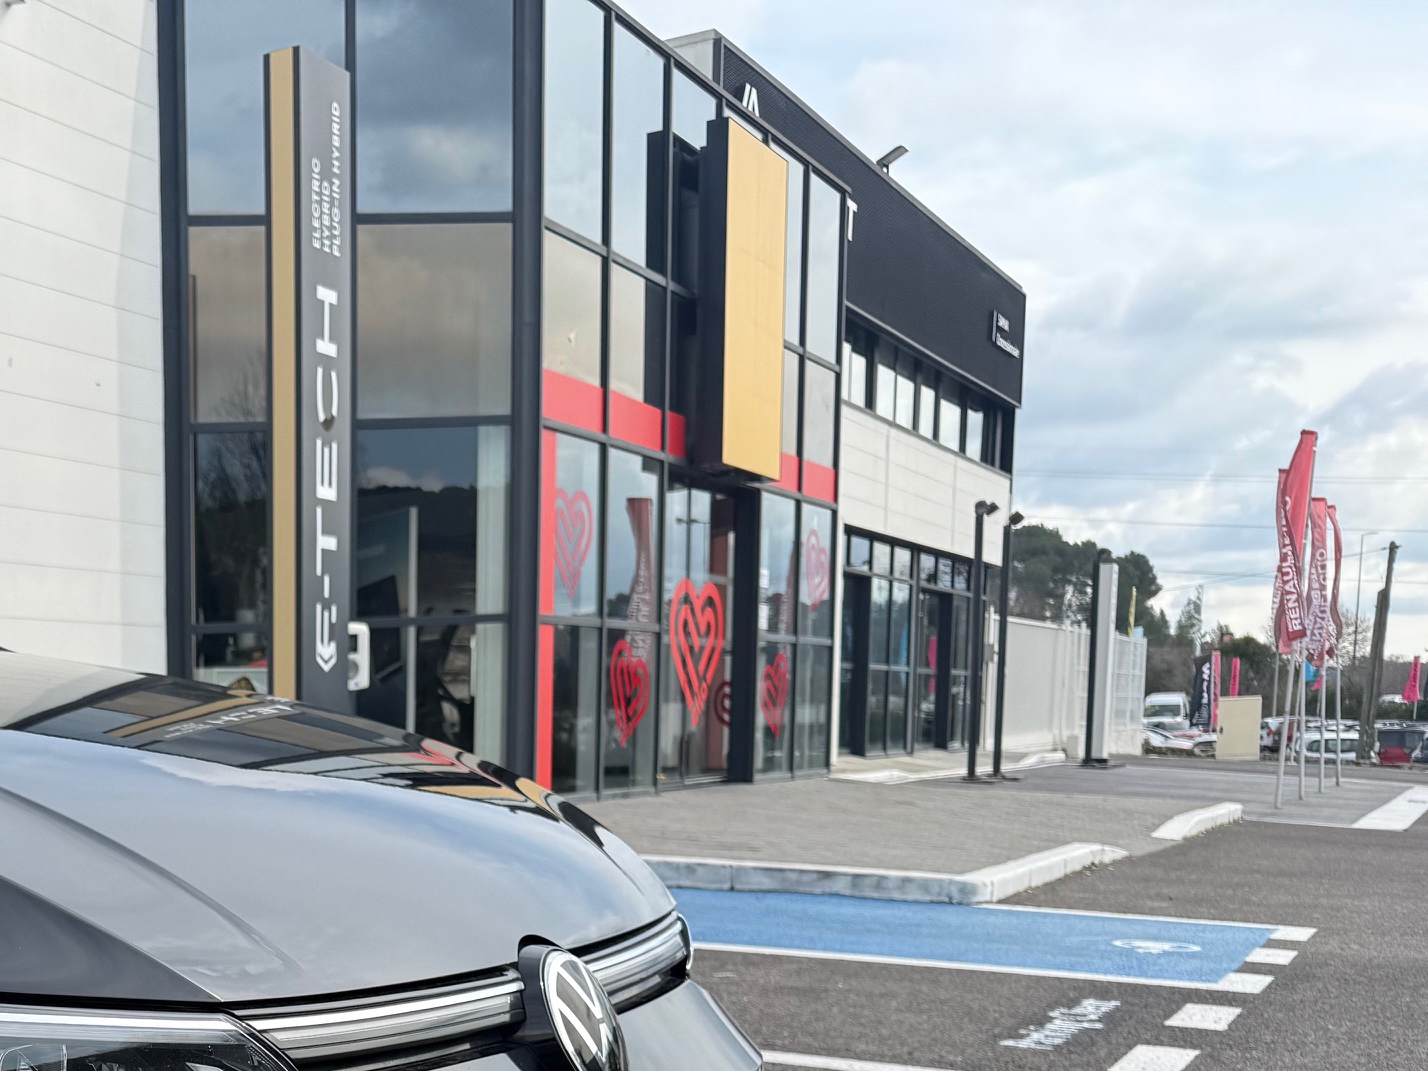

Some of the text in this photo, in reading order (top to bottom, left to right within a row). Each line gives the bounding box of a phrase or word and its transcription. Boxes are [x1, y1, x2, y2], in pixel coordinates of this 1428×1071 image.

[312, 157, 321, 249] ELECTRIC
[322, 181, 331, 253] HYBRID
[332, 102, 341, 258] PLUG-IN HYBRID
[315, 284, 339, 673] E-TECH
